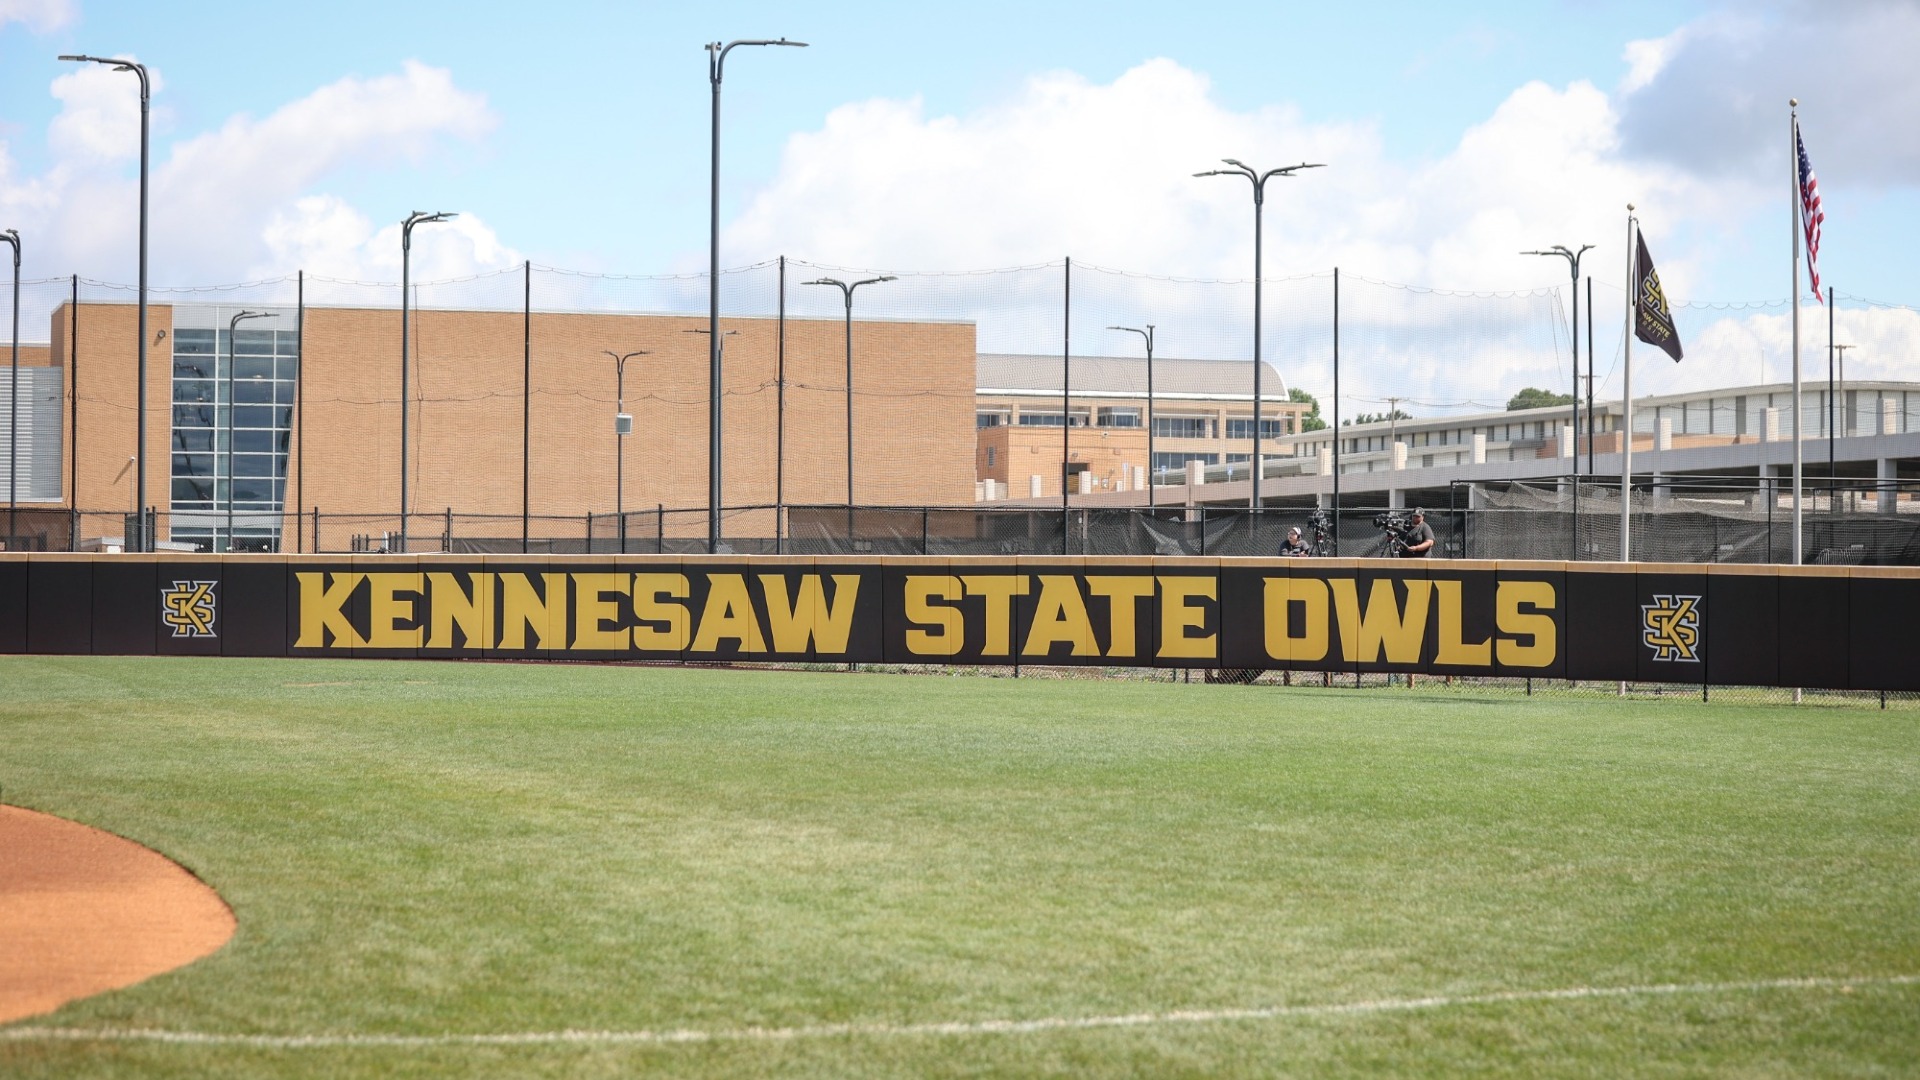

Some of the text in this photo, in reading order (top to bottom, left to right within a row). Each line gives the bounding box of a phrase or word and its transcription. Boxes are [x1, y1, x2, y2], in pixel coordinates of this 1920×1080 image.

[1652, 321, 1671, 338] STATE
[294, 572, 1556, 668] KENNESAW STATE OWLS
